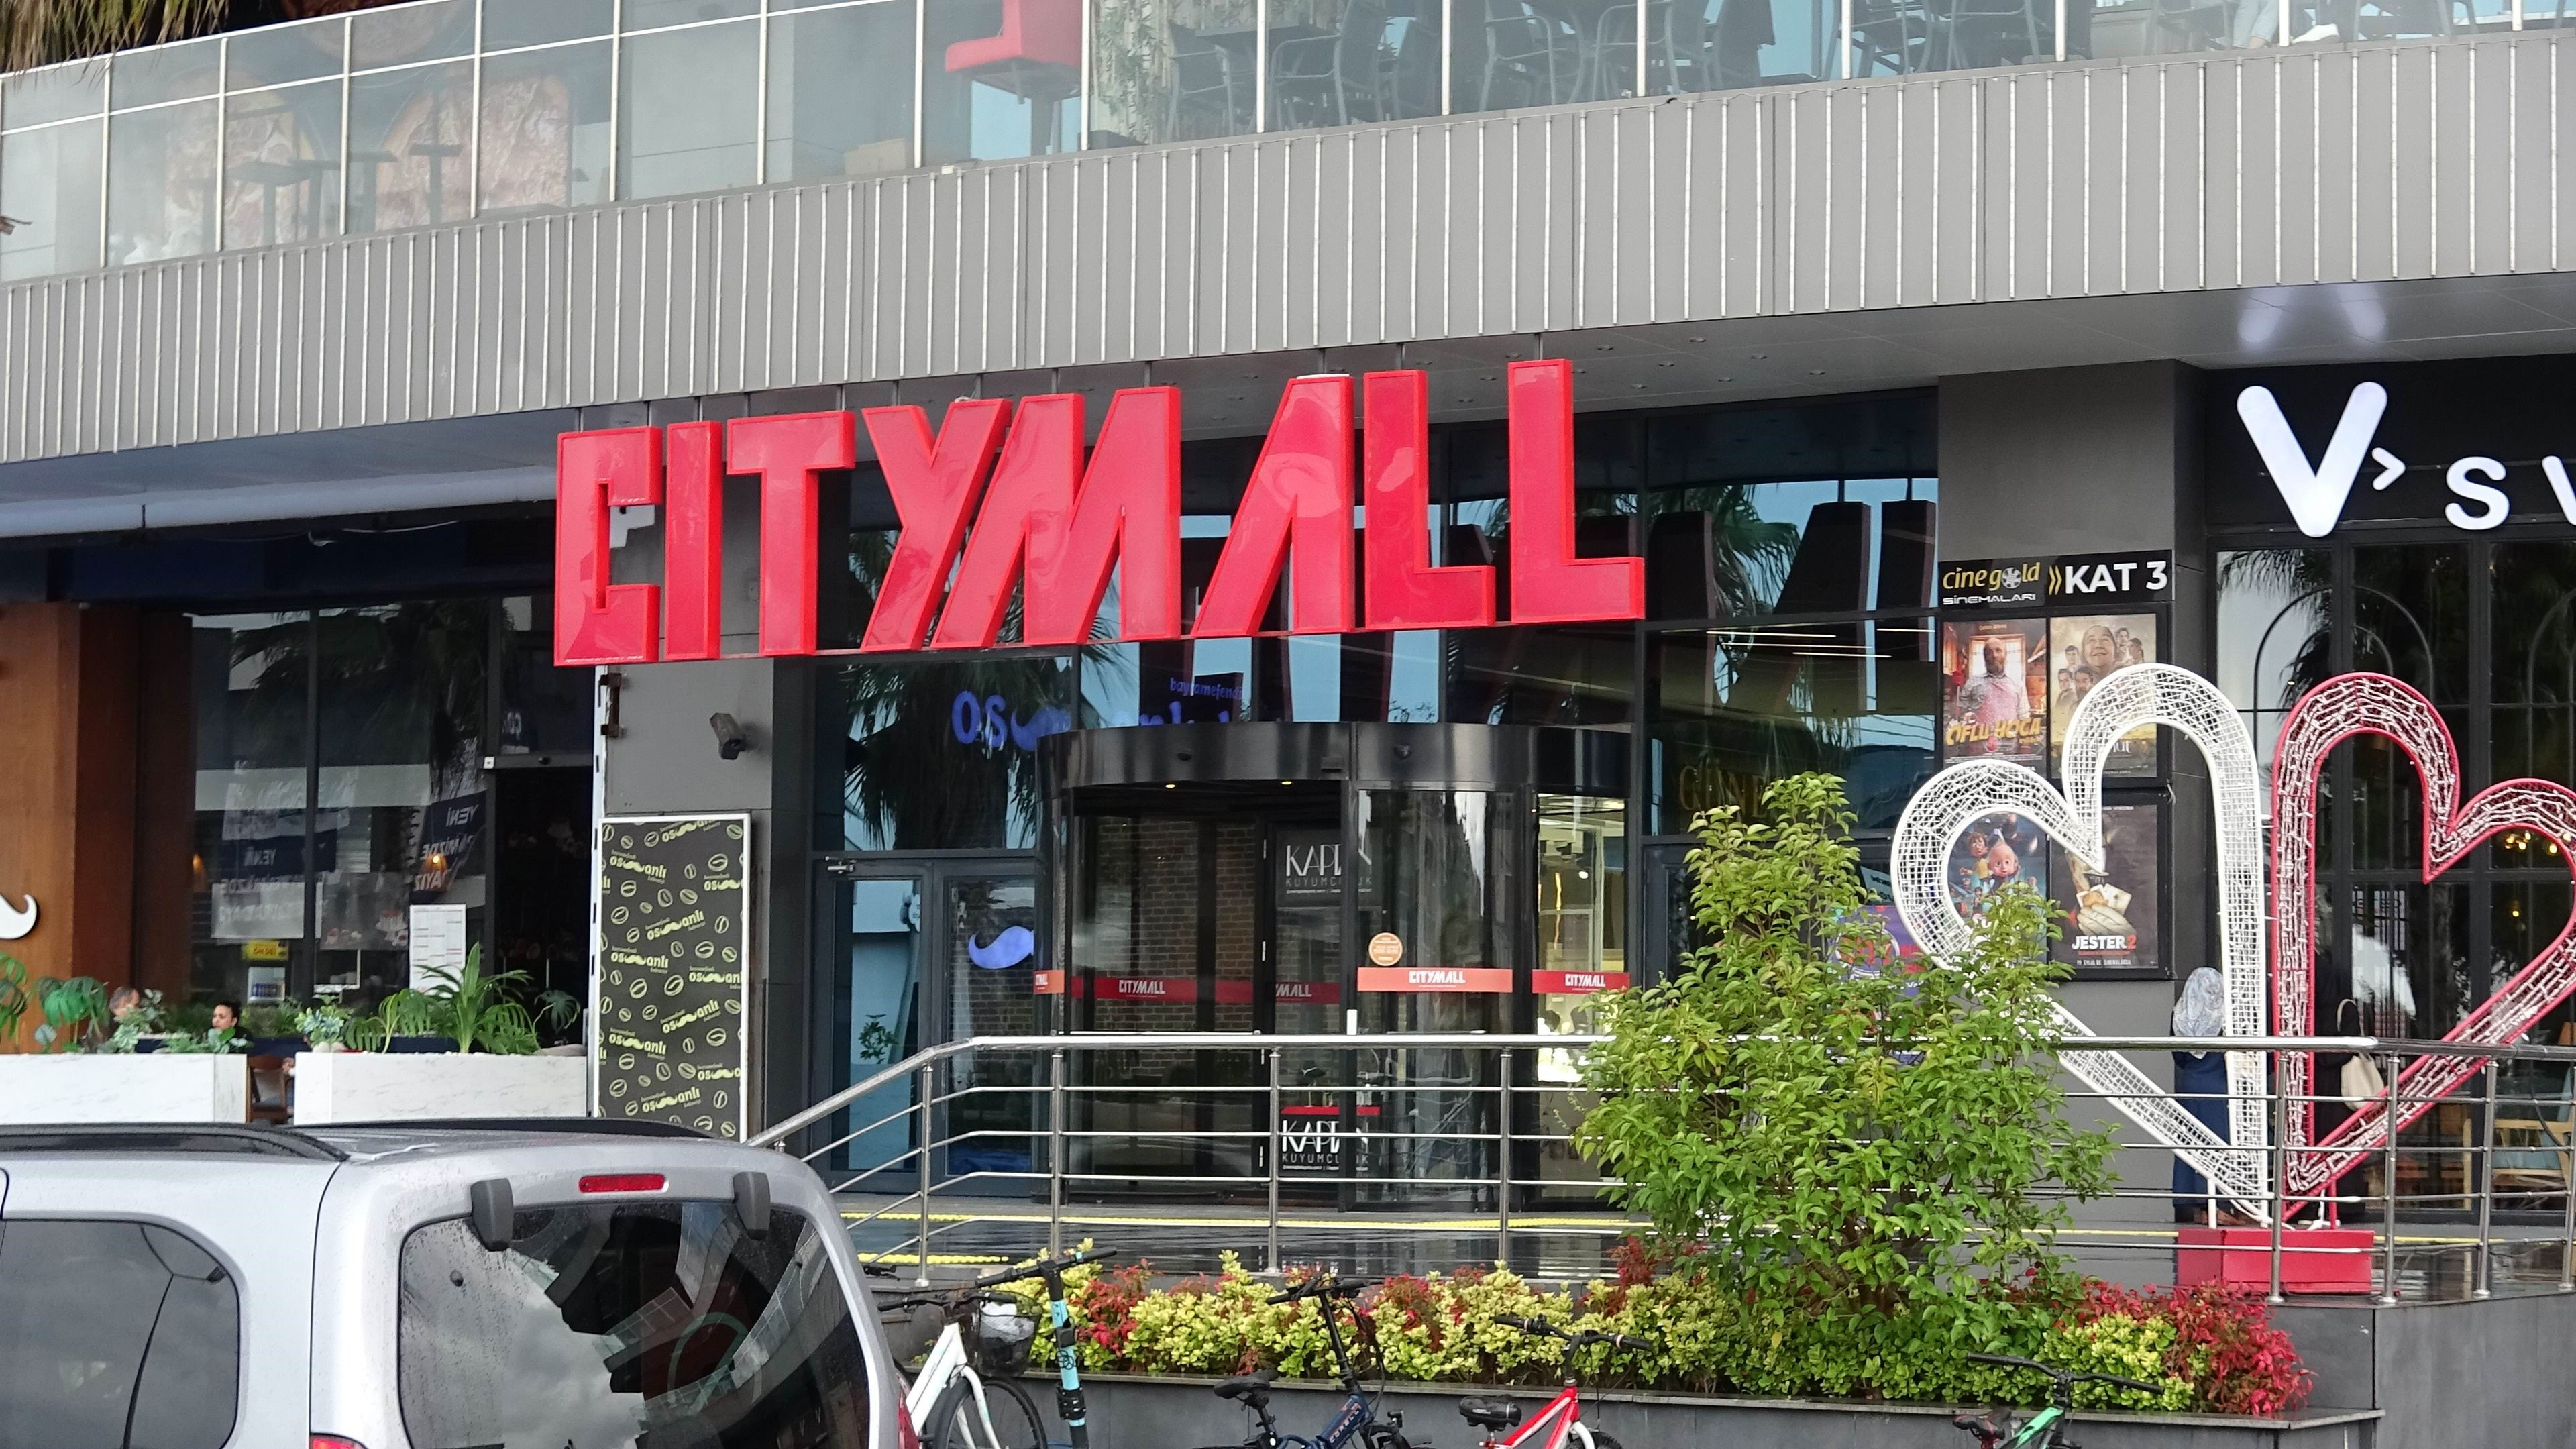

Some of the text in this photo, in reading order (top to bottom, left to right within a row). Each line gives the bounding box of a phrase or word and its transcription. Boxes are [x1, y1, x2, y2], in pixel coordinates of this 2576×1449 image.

[554, 358, 1645, 666] CITYMALL
[2065, 561, 2168, 594] KAT 3
[1994, 717, 2041, 739] HOCA
[1118, 979, 1166, 994] CITYMALL
[1409, 971, 1466, 984] CITYMALL
[1565, 973, 1605, 987] CITYMALL
